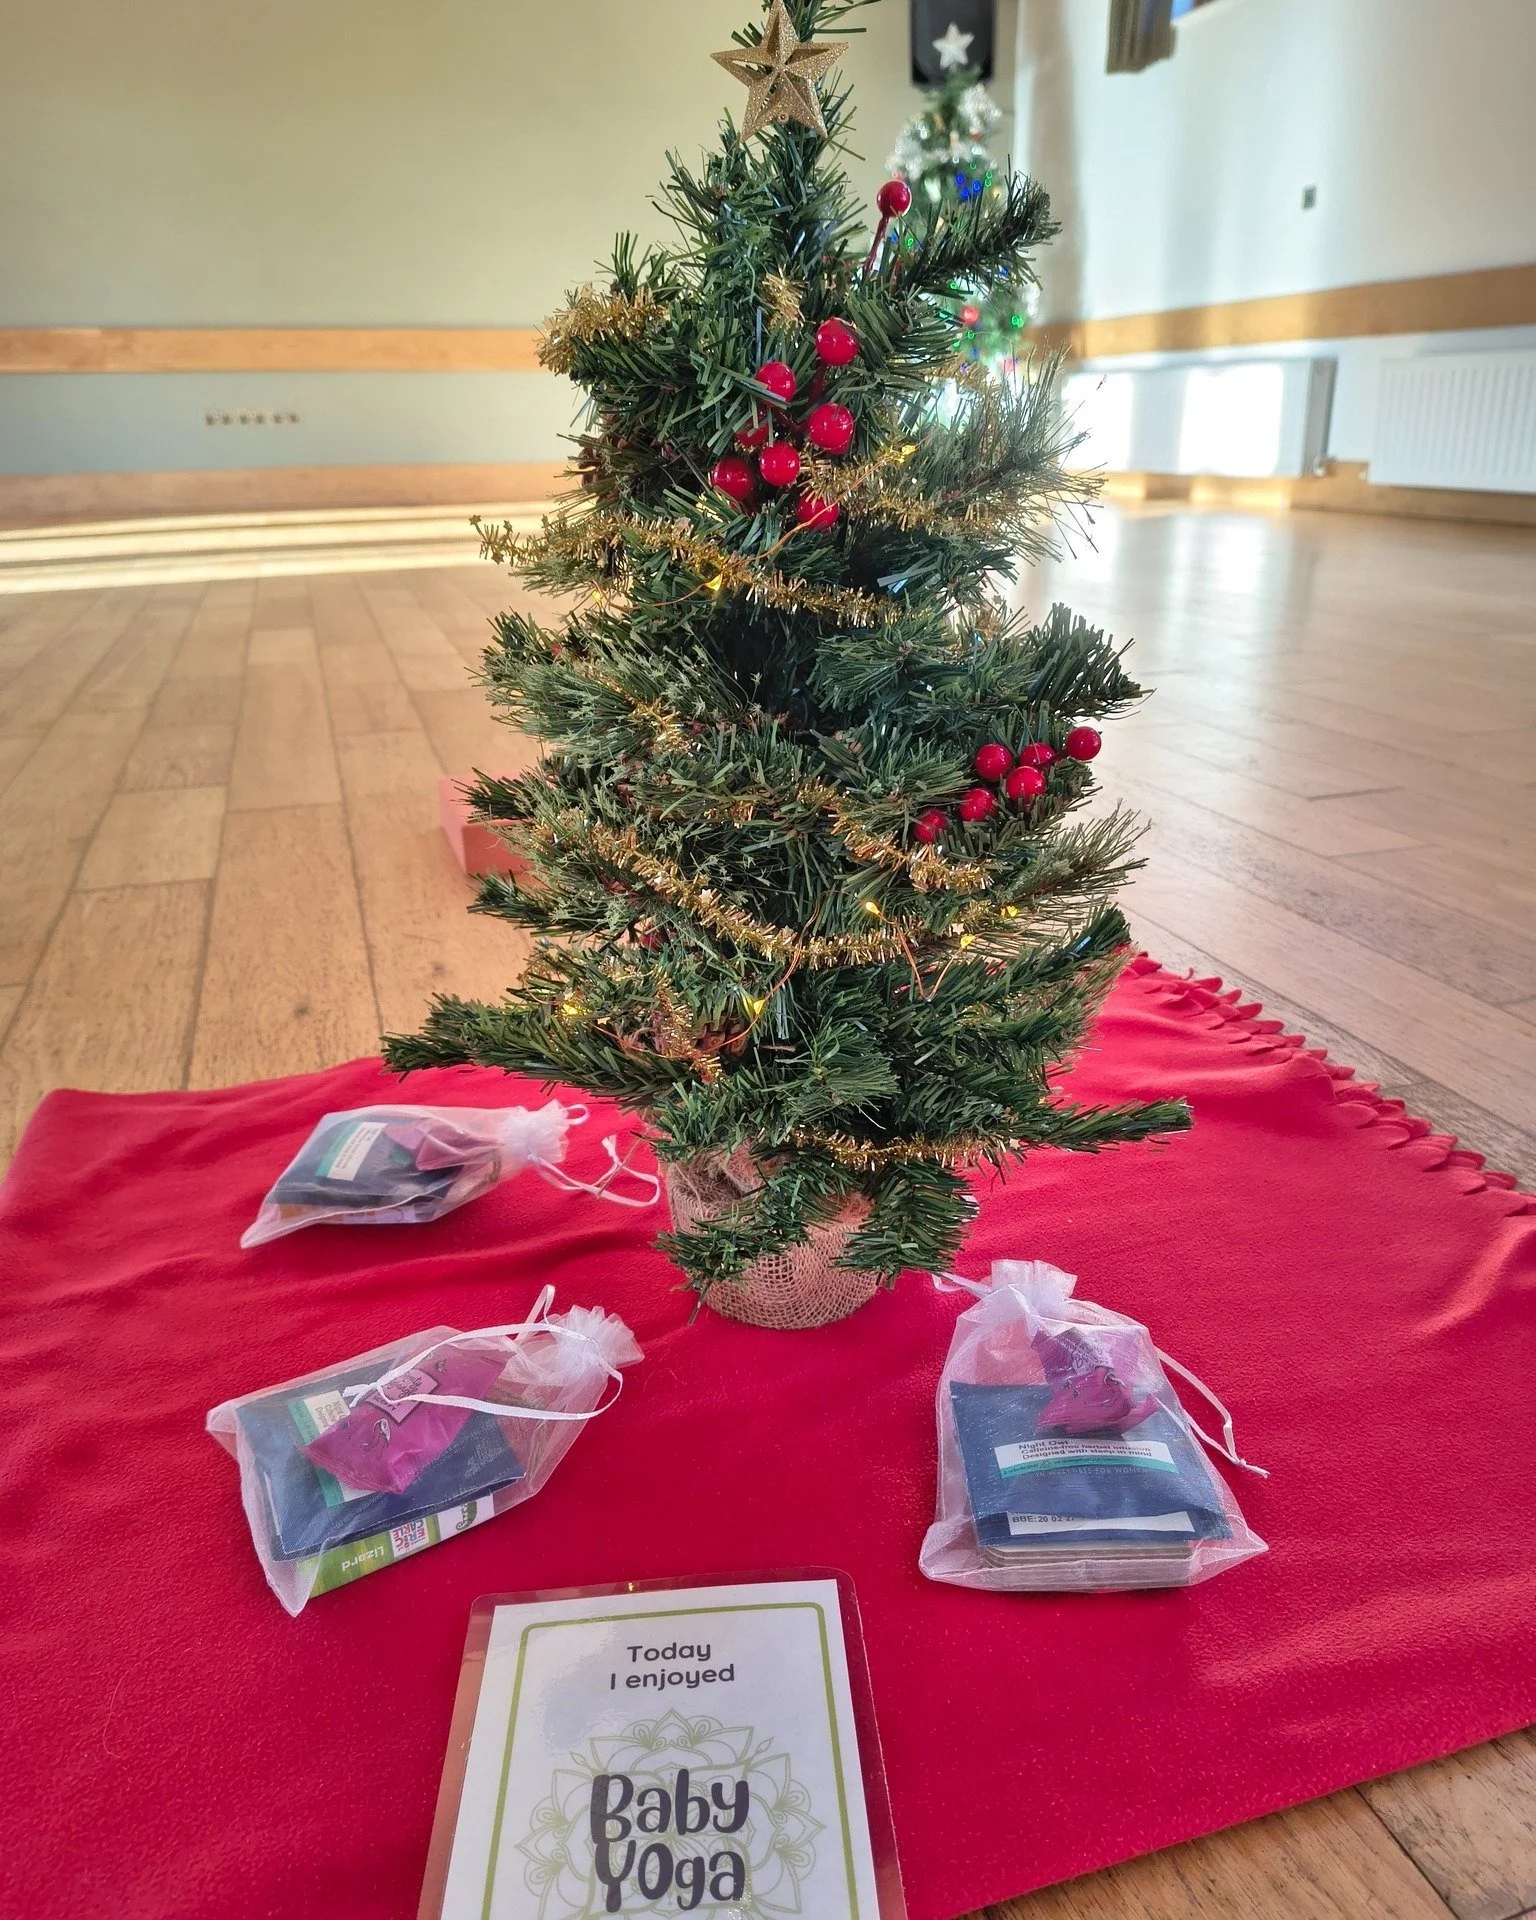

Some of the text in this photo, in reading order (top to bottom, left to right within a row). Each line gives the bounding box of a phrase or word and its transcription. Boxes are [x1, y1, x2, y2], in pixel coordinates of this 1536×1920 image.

[1018, 1441, 1046, 1450] Night
[1022, 1450, 1066, 1460] Designed
[394, 1526, 426, 1548] ERIC
[341, 1546, 384, 1572] Lizard
[627, 1642, 711, 1662] Today
[609, 1664, 735, 1691] I enjoyed
[590, 1768, 749, 1843] Baby
